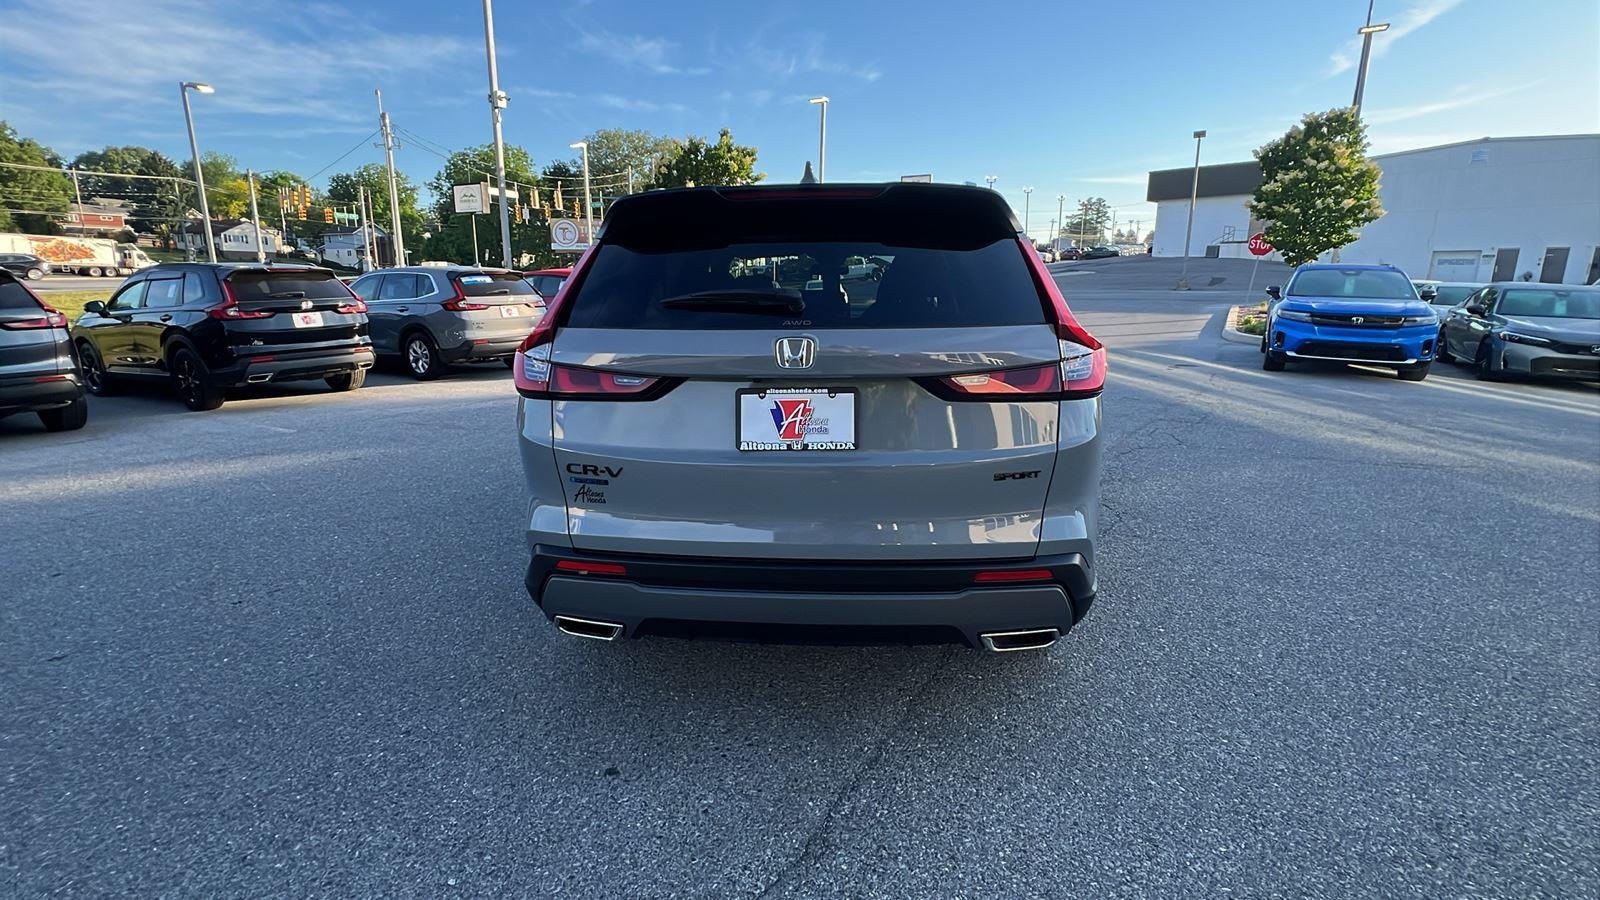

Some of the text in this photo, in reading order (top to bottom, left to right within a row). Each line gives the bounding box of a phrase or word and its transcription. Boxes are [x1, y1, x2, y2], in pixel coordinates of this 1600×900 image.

[1250, 239, 1271, 250] STOP
[799, 424, 829, 434] Honda
[740, 440, 787, 450] Altoona
[807, 441, 856, 450] HONDA
[566, 463, 624, 478] CR-V
[993, 470, 1042, 481] SPORT
